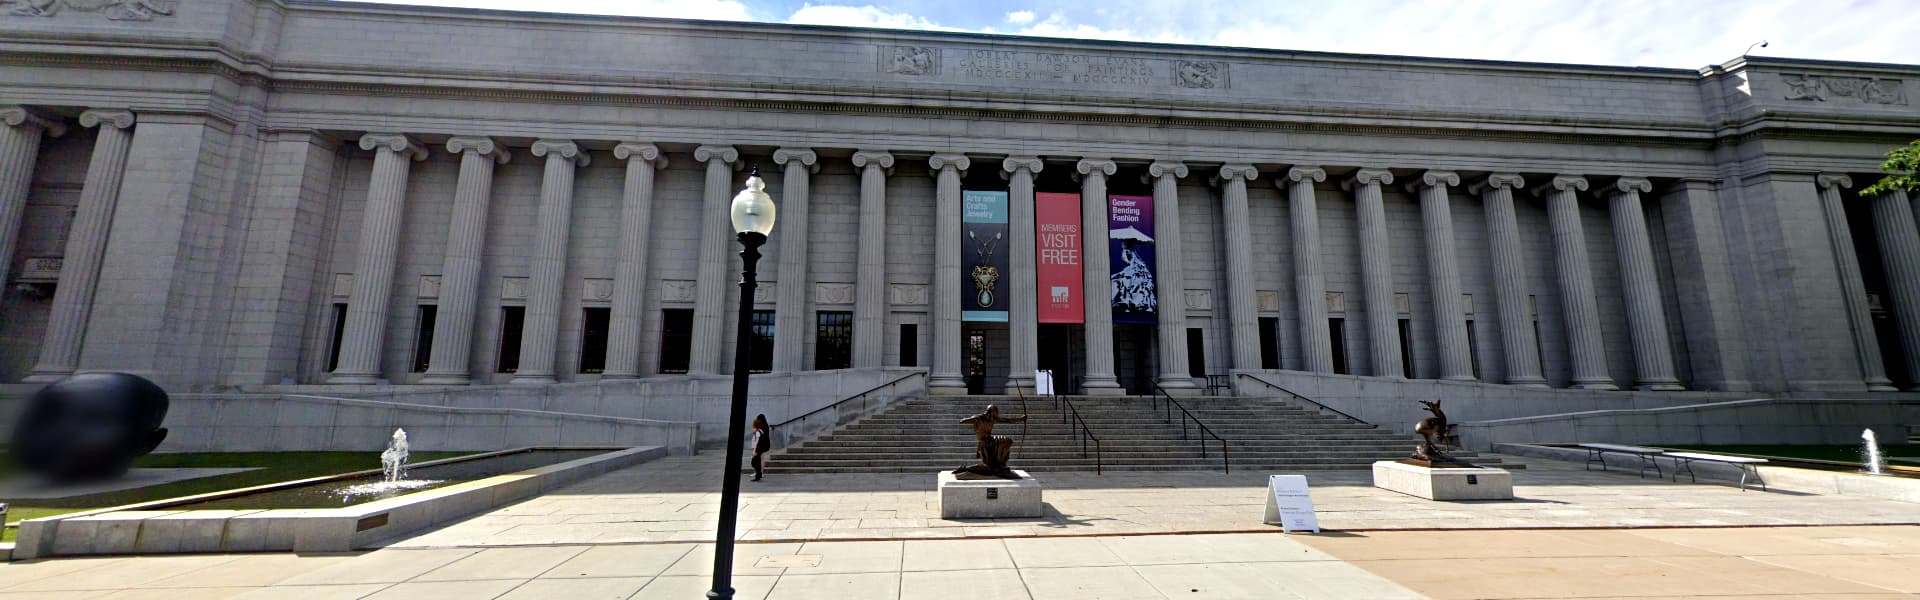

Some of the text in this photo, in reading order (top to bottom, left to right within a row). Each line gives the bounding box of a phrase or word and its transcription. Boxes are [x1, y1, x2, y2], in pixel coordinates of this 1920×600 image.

[967, 50, 1145, 67] ROBERT DAWSON EVANS
[959, 59, 1029, 70] GALLERIES
[1088, 64, 1154, 77] PAINTINGS
[1112, 199, 1136, 207] Gender
[966, 210, 993, 219] Jewelry
[1112, 207, 1140, 216] Bending
[1112, 214, 1140, 222] Fashion
[1041, 224, 1077, 233] MEMBERS
[1041, 233, 1077, 248] VISIT
[1041, 249, 1078, 265] FREE
